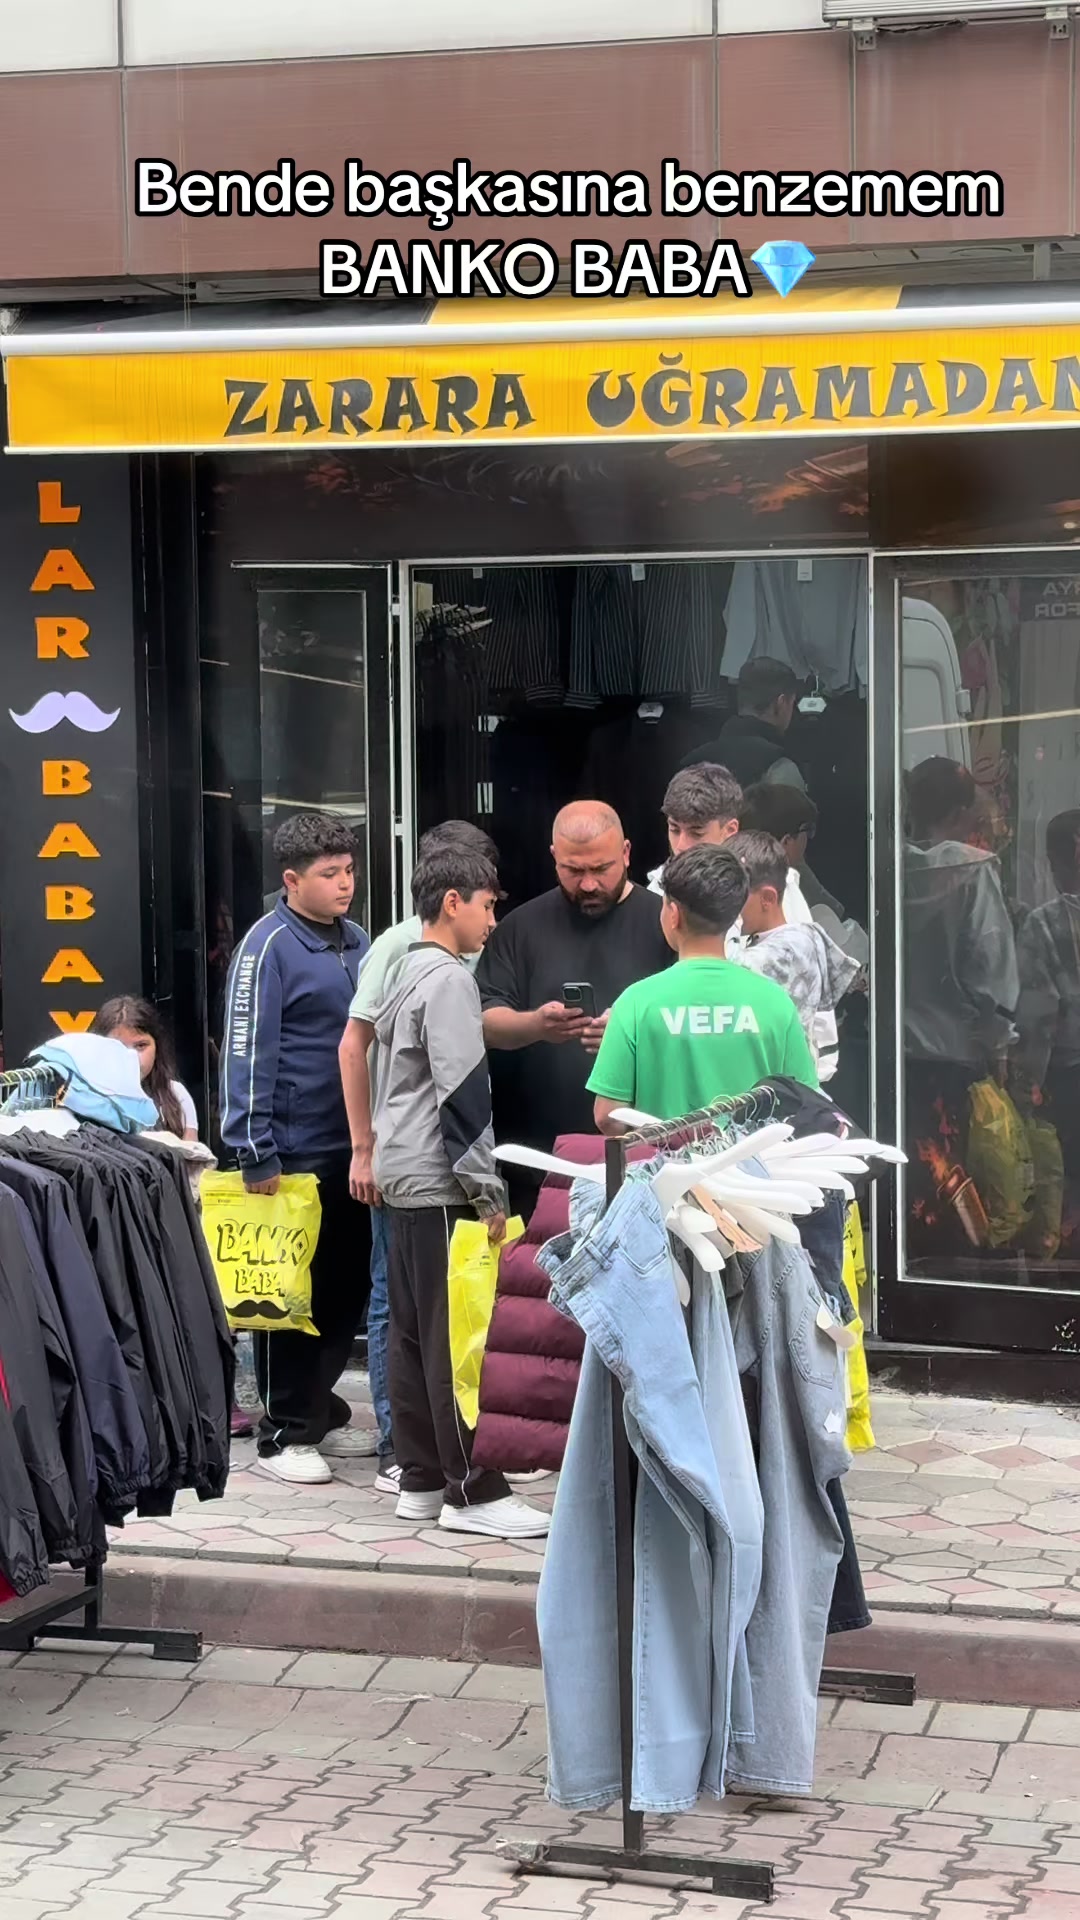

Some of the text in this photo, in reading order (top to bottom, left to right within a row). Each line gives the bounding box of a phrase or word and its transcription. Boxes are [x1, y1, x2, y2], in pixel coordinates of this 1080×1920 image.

[223, 372, 537, 438] ZARARA
[30, 481, 96, 660] LAR
[232, 954, 256, 1057] ARMANI EXCHANGE
[659, 1004, 761, 1036] VEFA
[216, 1218, 311, 1267] BANKO
[235, 1267, 286, 1298] BABA
